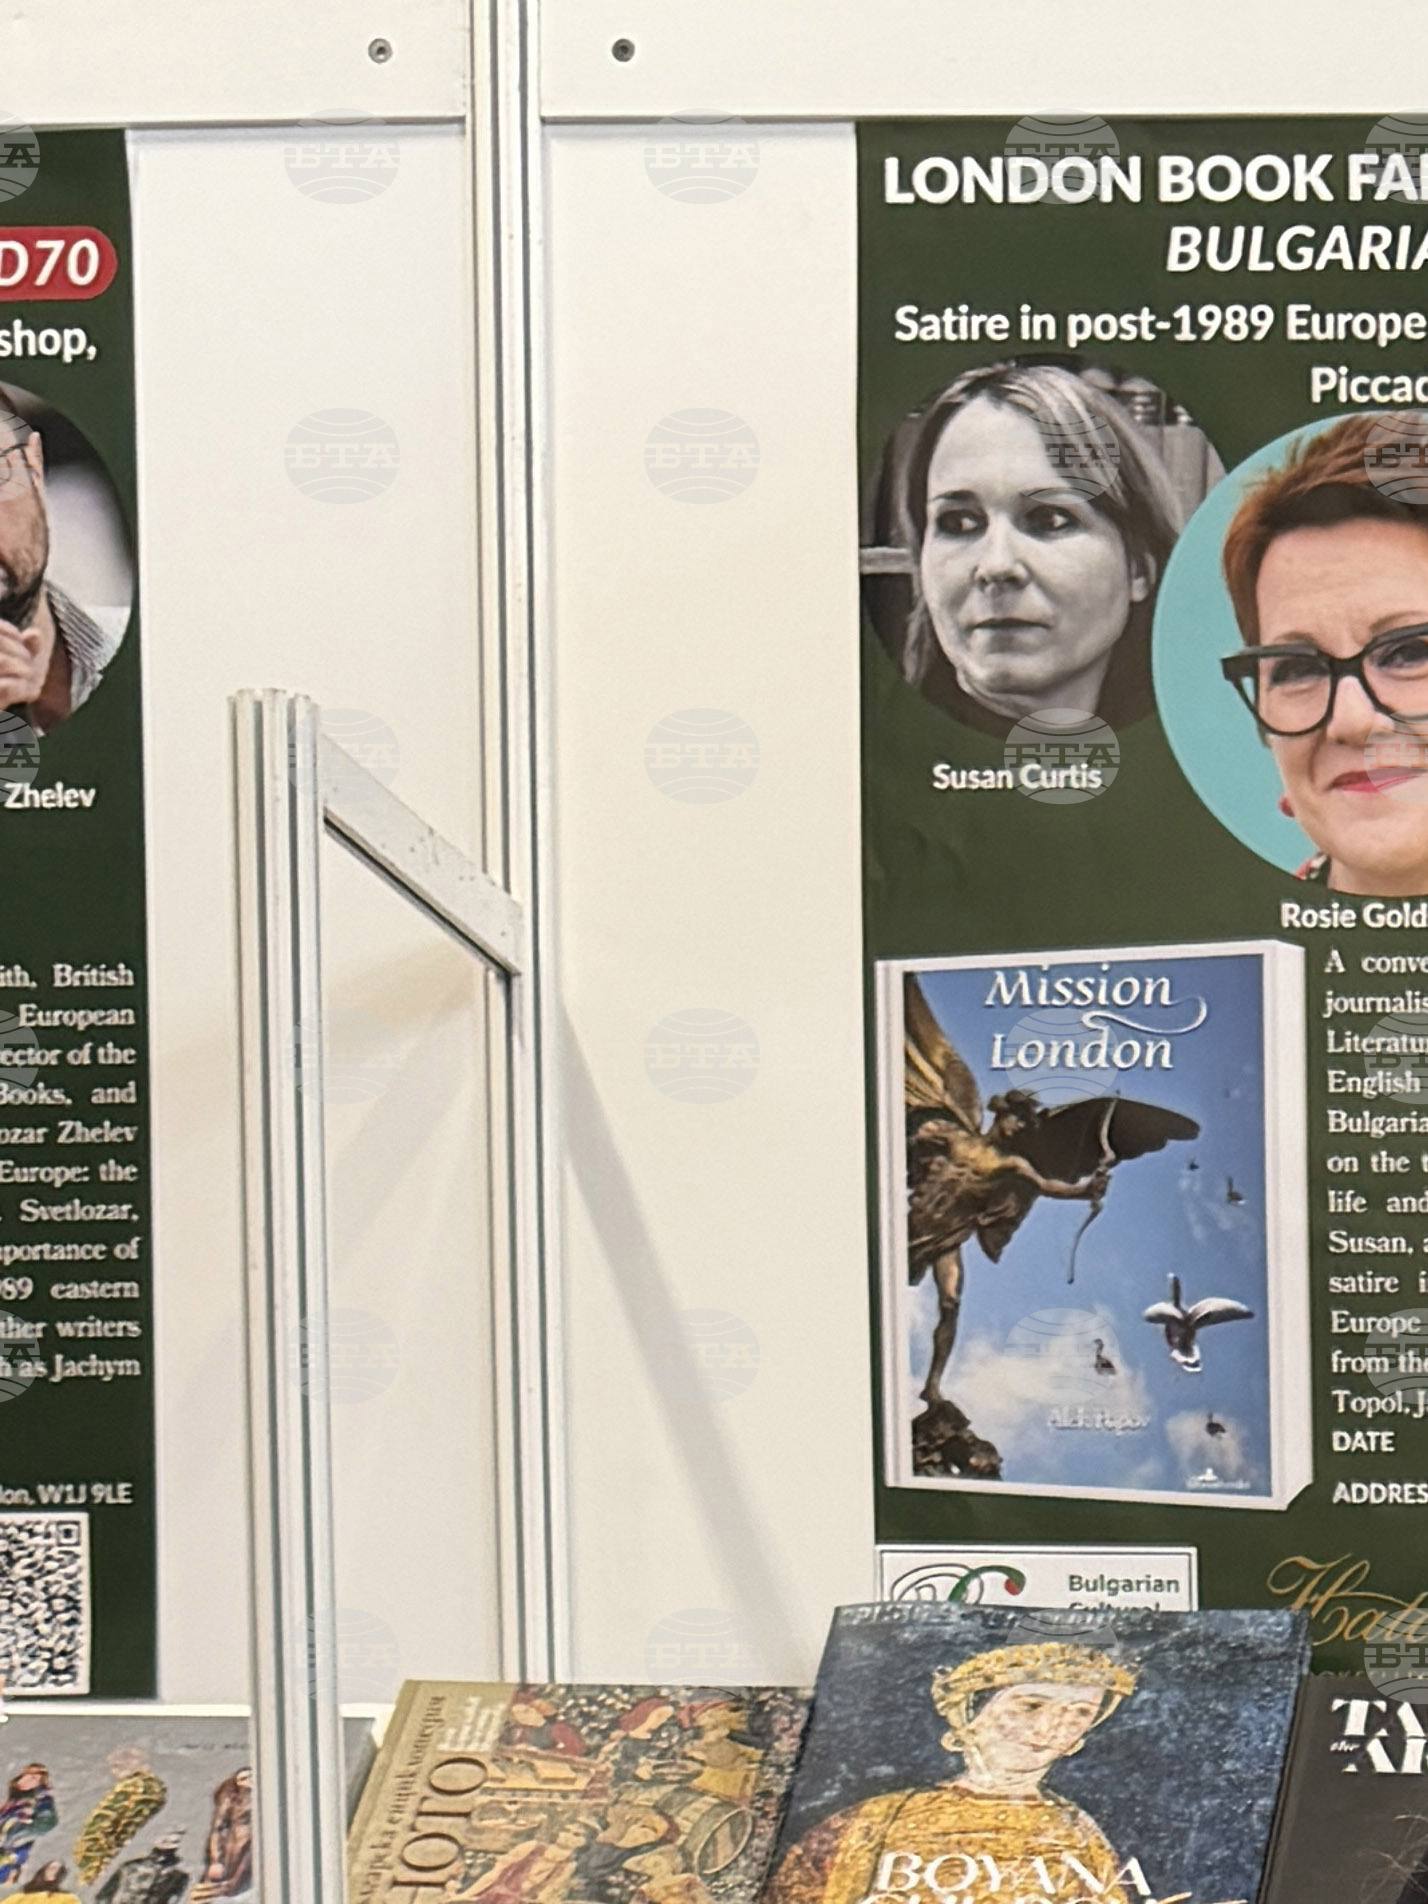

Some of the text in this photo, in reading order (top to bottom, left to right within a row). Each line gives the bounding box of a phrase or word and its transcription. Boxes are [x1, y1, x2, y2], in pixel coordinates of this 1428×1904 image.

[885, 155, 1141, 203] LONDON
[1159, 154, 1334, 202] BOOK
[895, 304, 1010, 341] Satire
[1020, 303, 1056, 340] in
[1067, 304, 1274, 348] post-1989
[1287, 304, 1427, 348] Europe
[933, 762, 1103, 790] Susan Curtis
[4, 782, 95, 810] Zhelev
[1281, 902, 1357, 929] Rosie
[1324, 949, 1346, 973] A
[52, 963, 135, 989] British
[984, 964, 1195, 1016] Mission
[989, 1031, 1173, 1070] London
[55, 1318, 142, 1339] writers
[50, 1354, 142, 1382] Jachym
[1332, 1430, 1395, 1452] DATE
[876, 1852, 1152, 1896] BOYANA
